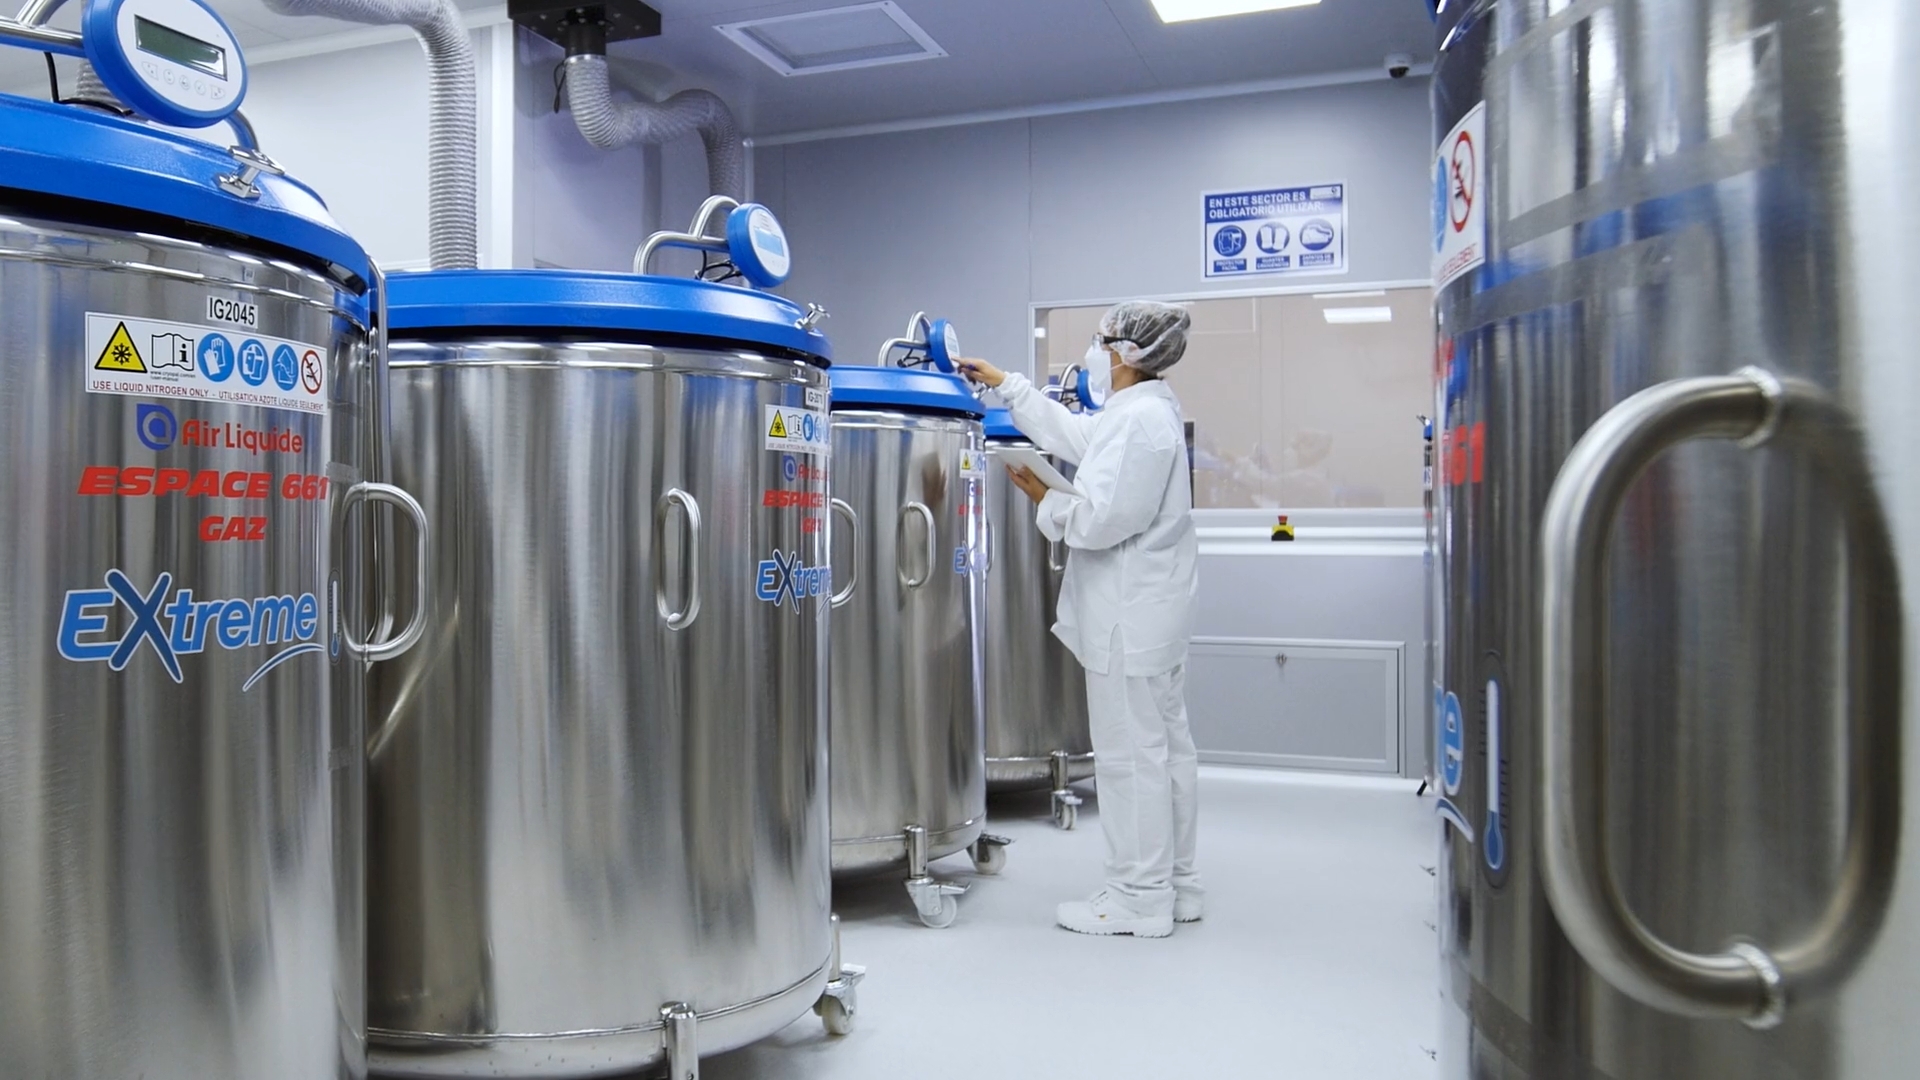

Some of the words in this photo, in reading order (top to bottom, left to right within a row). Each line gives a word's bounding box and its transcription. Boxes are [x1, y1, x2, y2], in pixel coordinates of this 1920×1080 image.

[1209, 198, 1223, 209] EN
[1224, 195, 1250, 207] ESTE
[1251, 191, 1291, 205] SECTOR
[1292, 191, 1306, 202] ES
[1209, 204, 1275, 219] OBLIGATORIO
[208, 299, 255, 326] IG2045
[93, 380, 111, 390] USE
[114, 382, 144, 393] LIQUID
[145, 384, 187, 396] NITROGEN
[189, 388, 209, 398] ONLY
[218, 390, 258, 403] UTILISATION
[259, 395, 277, 405] AZOTE
[181, 419, 221, 448] Air
[225, 422, 303, 456] Liquide
[77, 466, 273, 500] ESPACE
[281, 473, 329, 501] 661
[762, 489, 824, 508] ESPACE
[199, 515, 268, 542] GAZ
[57, 568, 319, 684] EXtreme
